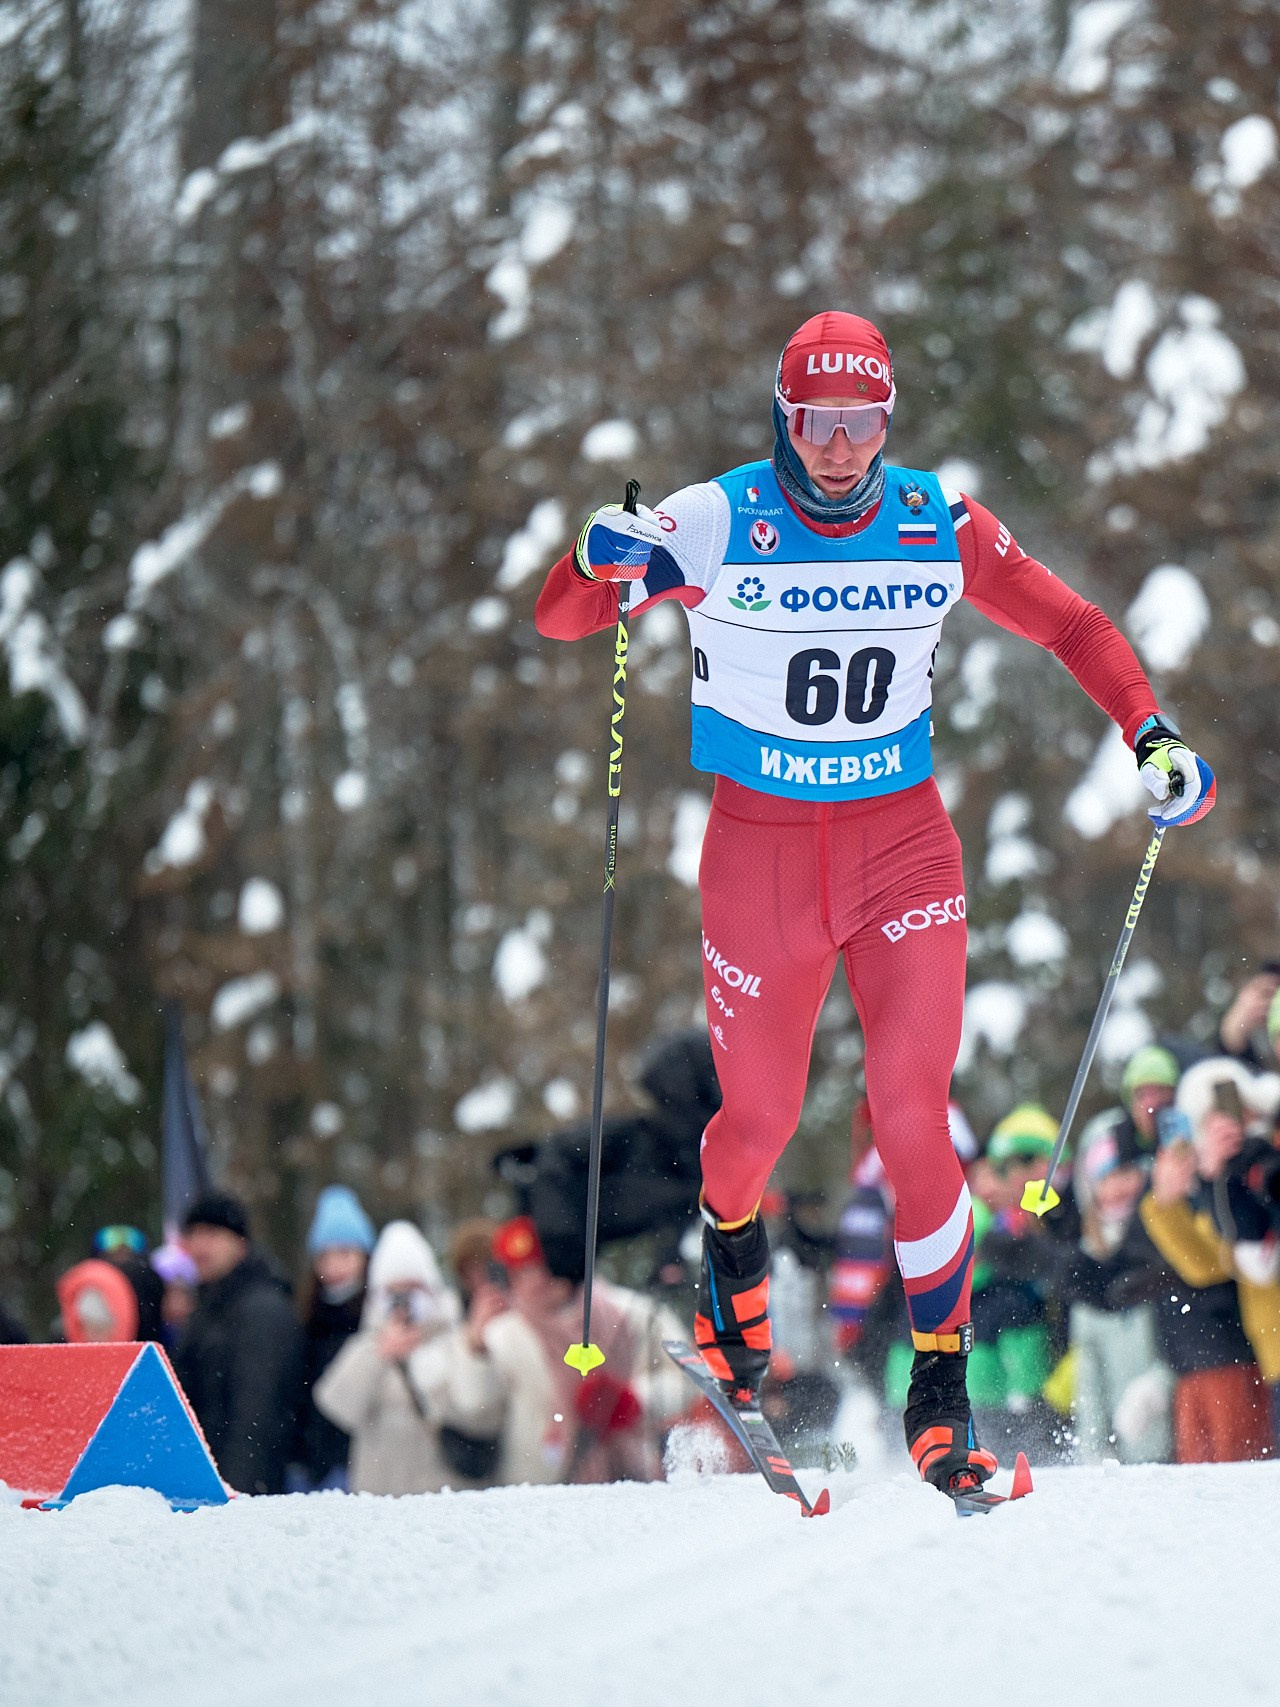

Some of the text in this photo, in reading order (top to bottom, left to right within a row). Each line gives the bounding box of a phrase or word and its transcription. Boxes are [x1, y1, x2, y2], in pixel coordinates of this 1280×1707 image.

[780, 582, 948, 613] ФОСАГРО
[785, 646, 897, 726] 60
[760, 743, 903, 785] ИЖЕВСК
[881, 894, 966, 943] BOSCO
[701, 929, 762, 998] UKOIL
